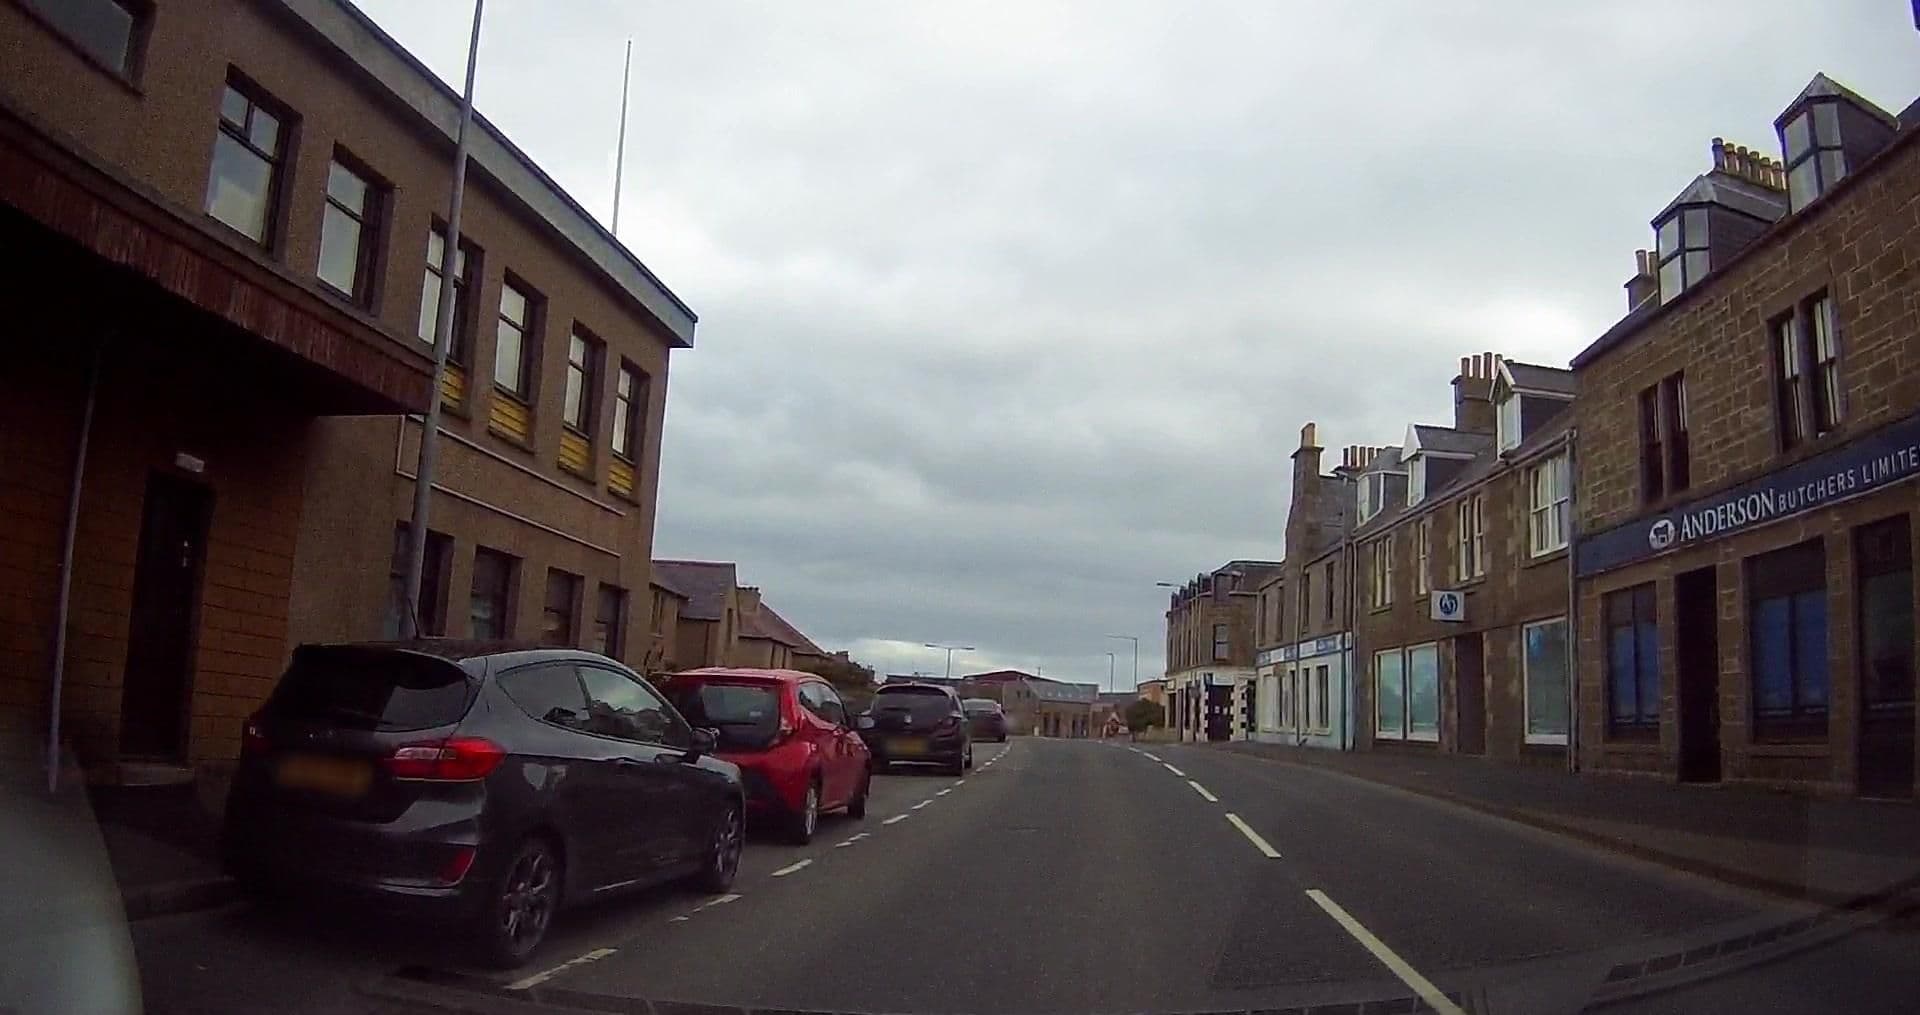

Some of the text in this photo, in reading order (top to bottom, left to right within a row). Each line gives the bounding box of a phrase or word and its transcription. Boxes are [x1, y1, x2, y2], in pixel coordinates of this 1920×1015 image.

[1680, 445, 1920, 541] ANDERSON BUTCHERS LIMITE
